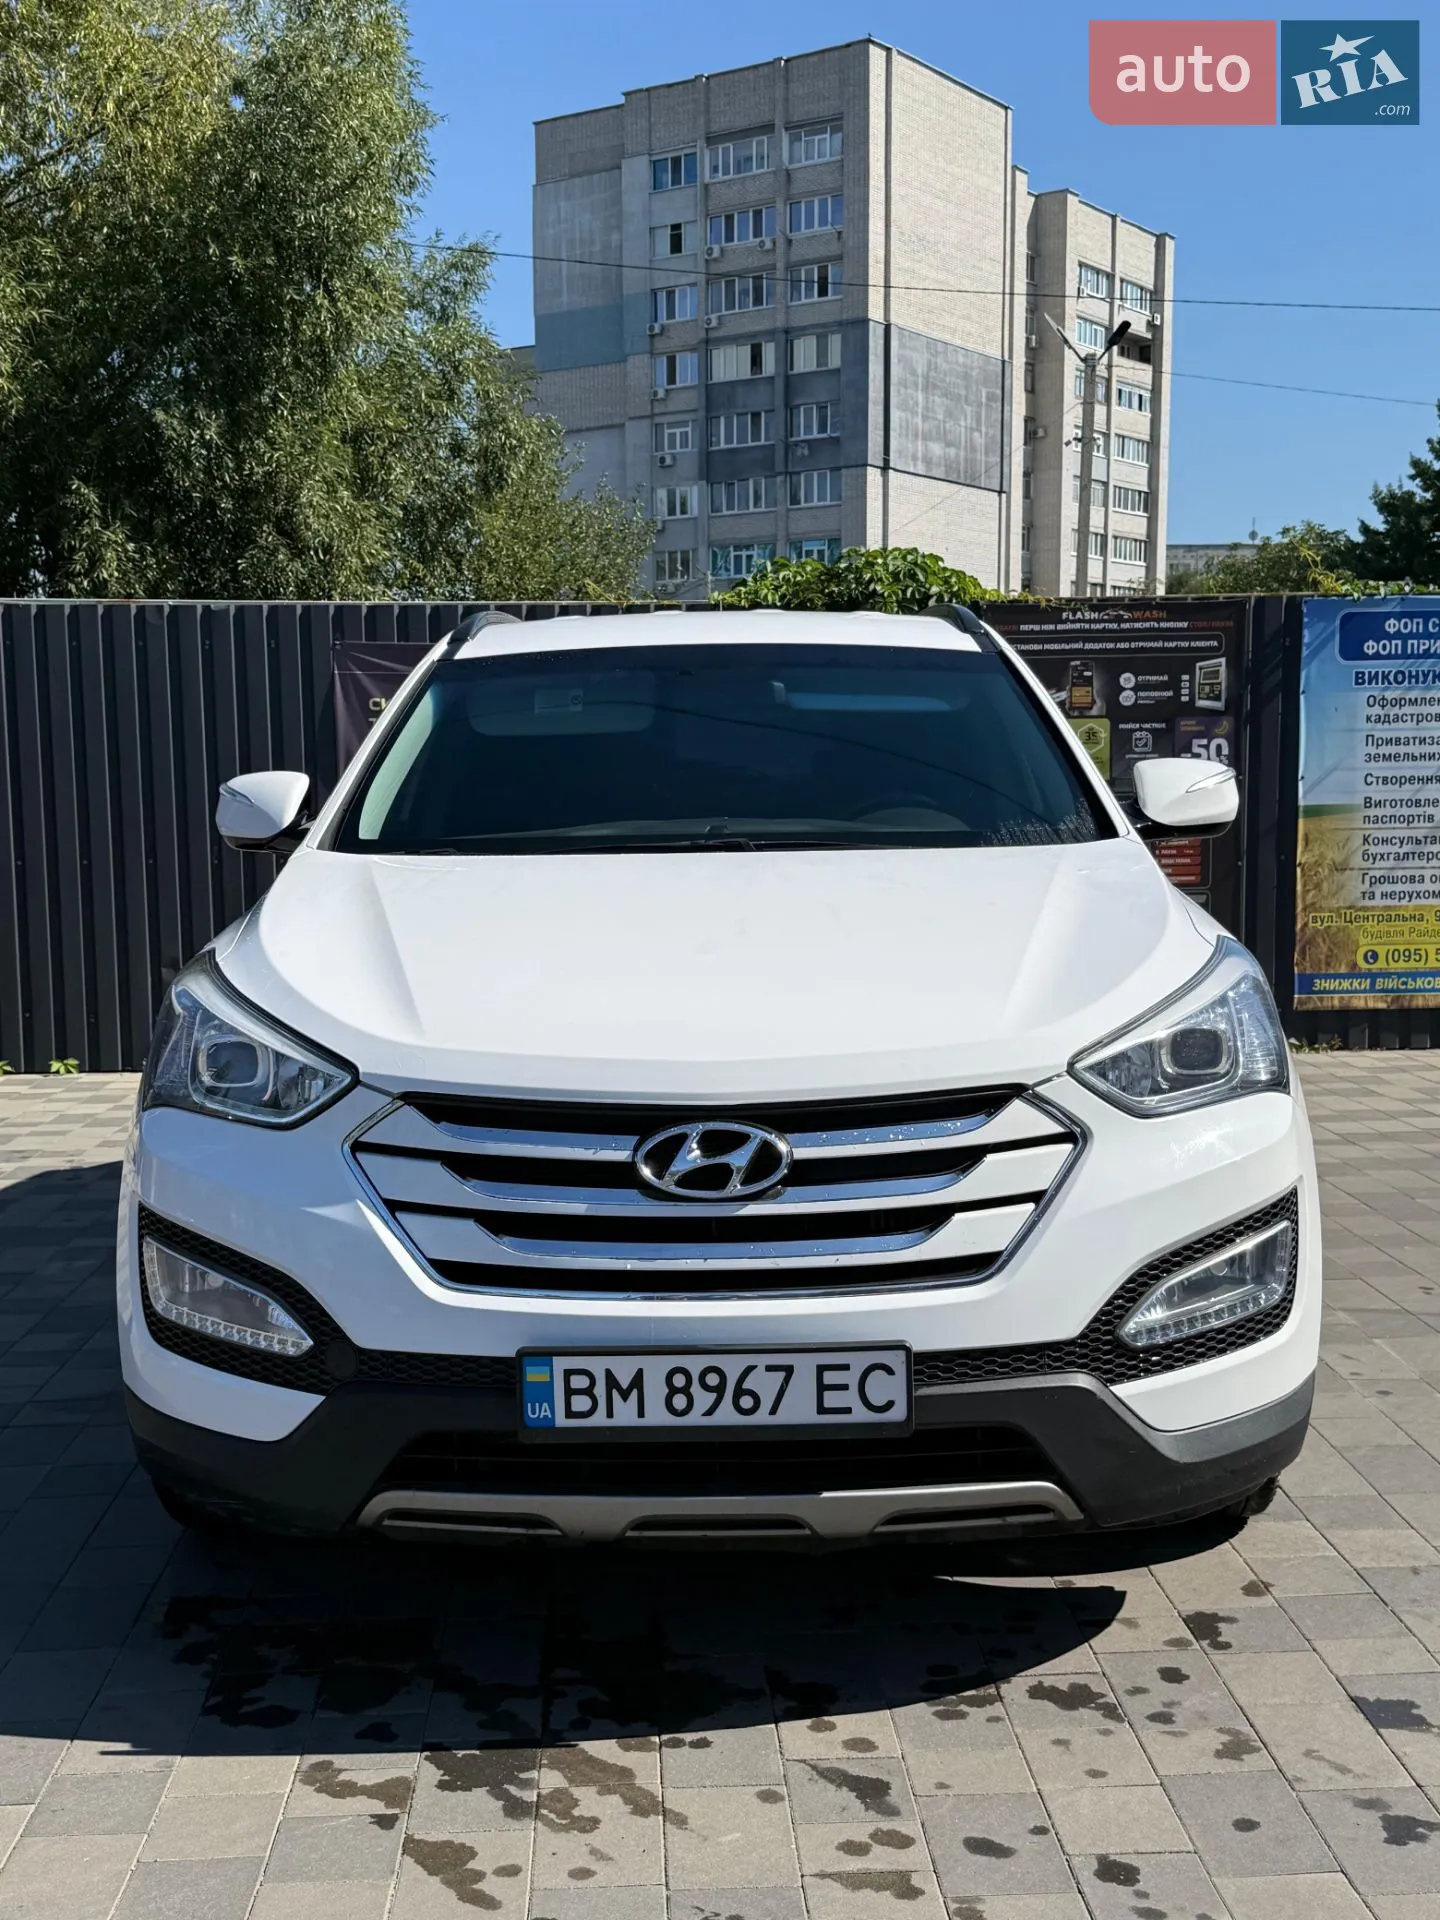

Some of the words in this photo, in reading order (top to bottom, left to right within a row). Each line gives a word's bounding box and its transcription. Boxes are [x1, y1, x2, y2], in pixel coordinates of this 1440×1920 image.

[1062, 611, 1098, 620] FLASH
[1133, 610, 1167, 619] WASH
[1384, 617, 1424, 634] ФОП
[1084, 641, 1115, 650] ДОДАТОК
[1116, 641, 1130, 649] АБО
[1164, 640, 1189, 648] КАРТКУ
[1363, 639, 1402, 656] ФОП
[1363, 811, 1435, 827] паспортів
[1361, 872, 1425, 888] Грошова
[1360, 889, 1376, 901] та
[1311, 914, 1339, 927] вул.
[1343, 911, 1430, 925] Центральна,
[1362, 928, 1405, 941] будівля
[1385, 948, 1429, 966] (095)
[1312, 978, 1371, 991] ЗНИЖКИ
[527, 1402, 552, 1419] UA
[563, 1367, 646, 1420] BM
[664, 1364, 795, 1418] 8967
[816, 1362, 896, 1416] EC
